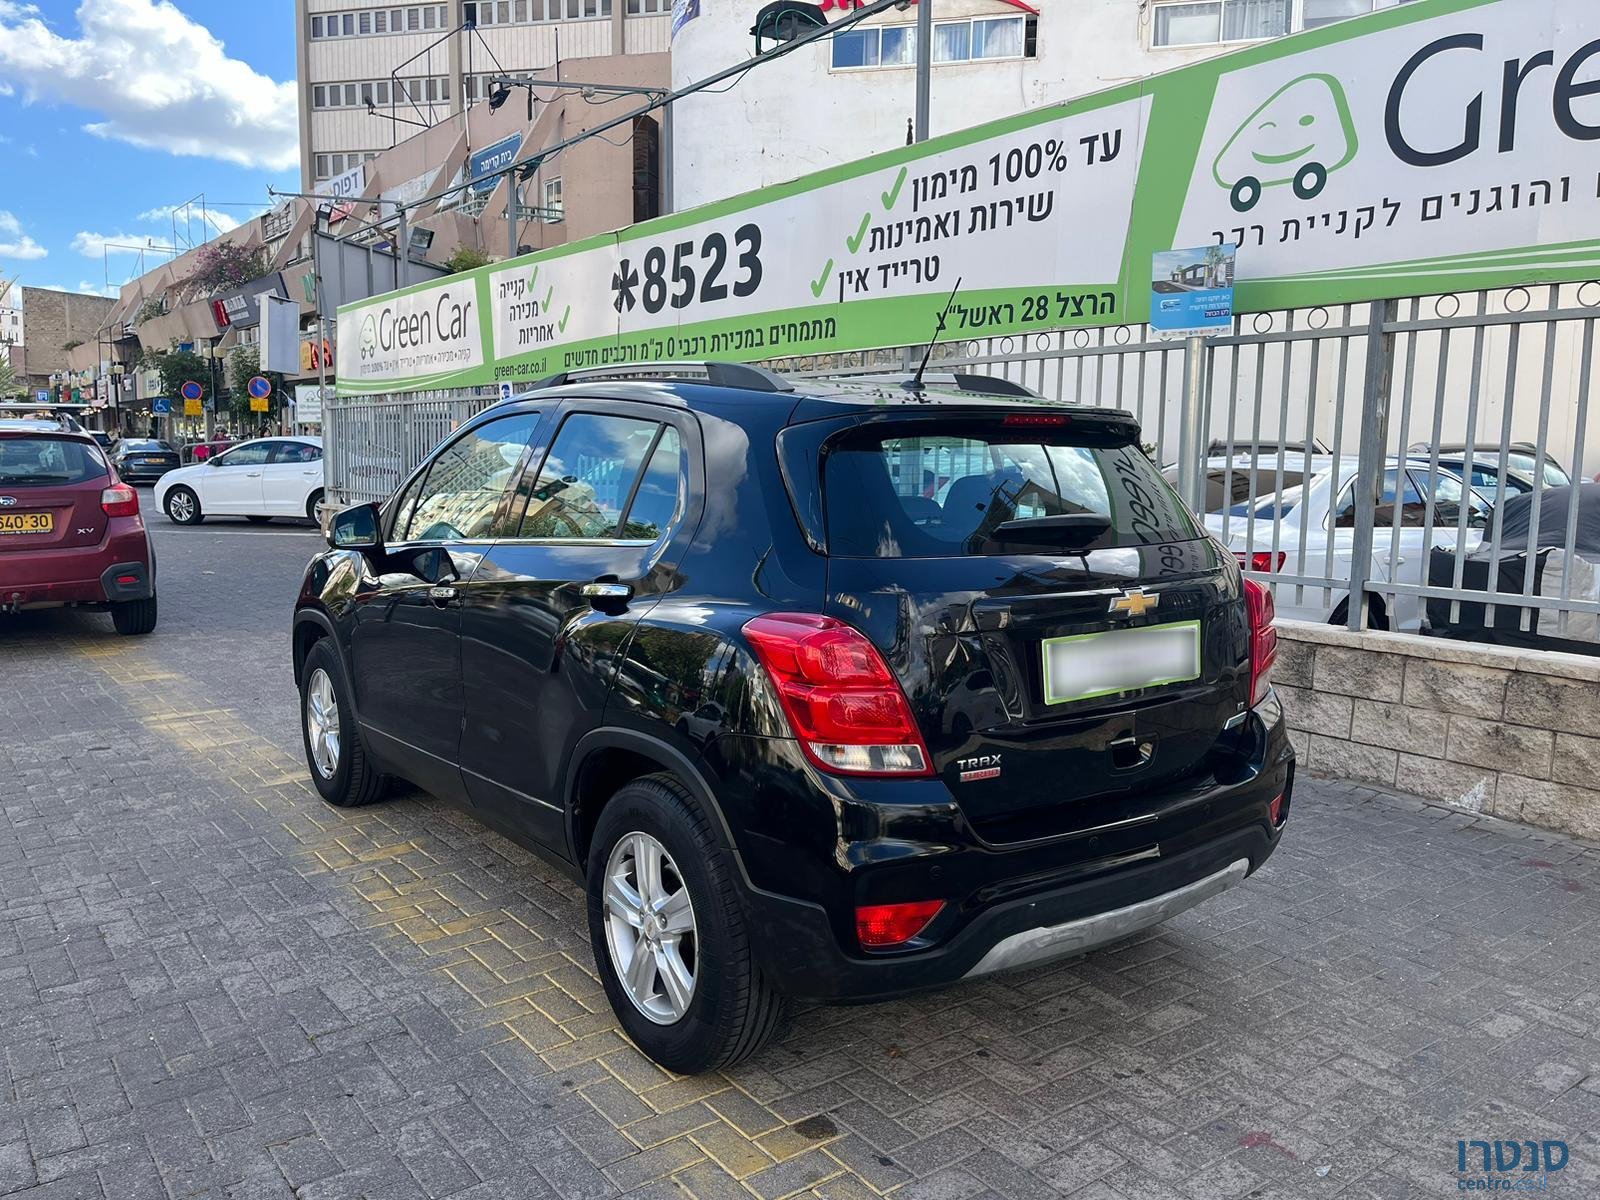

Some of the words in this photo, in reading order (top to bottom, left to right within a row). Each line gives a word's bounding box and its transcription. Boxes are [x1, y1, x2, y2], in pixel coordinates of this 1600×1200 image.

[1079, 129, 1123, 167] עד
[988, 139, 1068, 187] 100%
[332, 172, 359, 198] דפוס
[912, 165, 978, 213] מימון
[967, 190, 1055, 234] שירות
[1420, 176, 1570, 222] והוגנים
[868, 211, 960, 253] ואמינות
[1278, 196, 1402, 243] לקניית
[838, 266, 870, 304] אין
[877, 255, 941, 289] טרייד
[499, 278, 525, 300] קנייה
[509, 301, 539, 322] מכירה
[1021, 295, 1049, 320] 28
[1056, 291, 1116, 318] הרצל
[380, 308, 431, 352] Green
[436, 293, 471, 341] Car
[518, 323, 554, 345] אחריות
[769, 317, 836, 346] מתמחים
[678, 336, 706, 356] רכבי
[710, 329, 764, 353] במכירת
[564, 349, 598, 368] חדשים
[602, 345, 637, 364] ורכבים
[494, 357, 547, 380] green-car.co.il
[77, 527, 94, 535] XV
[957, 754, 1002, 770] TRAX
